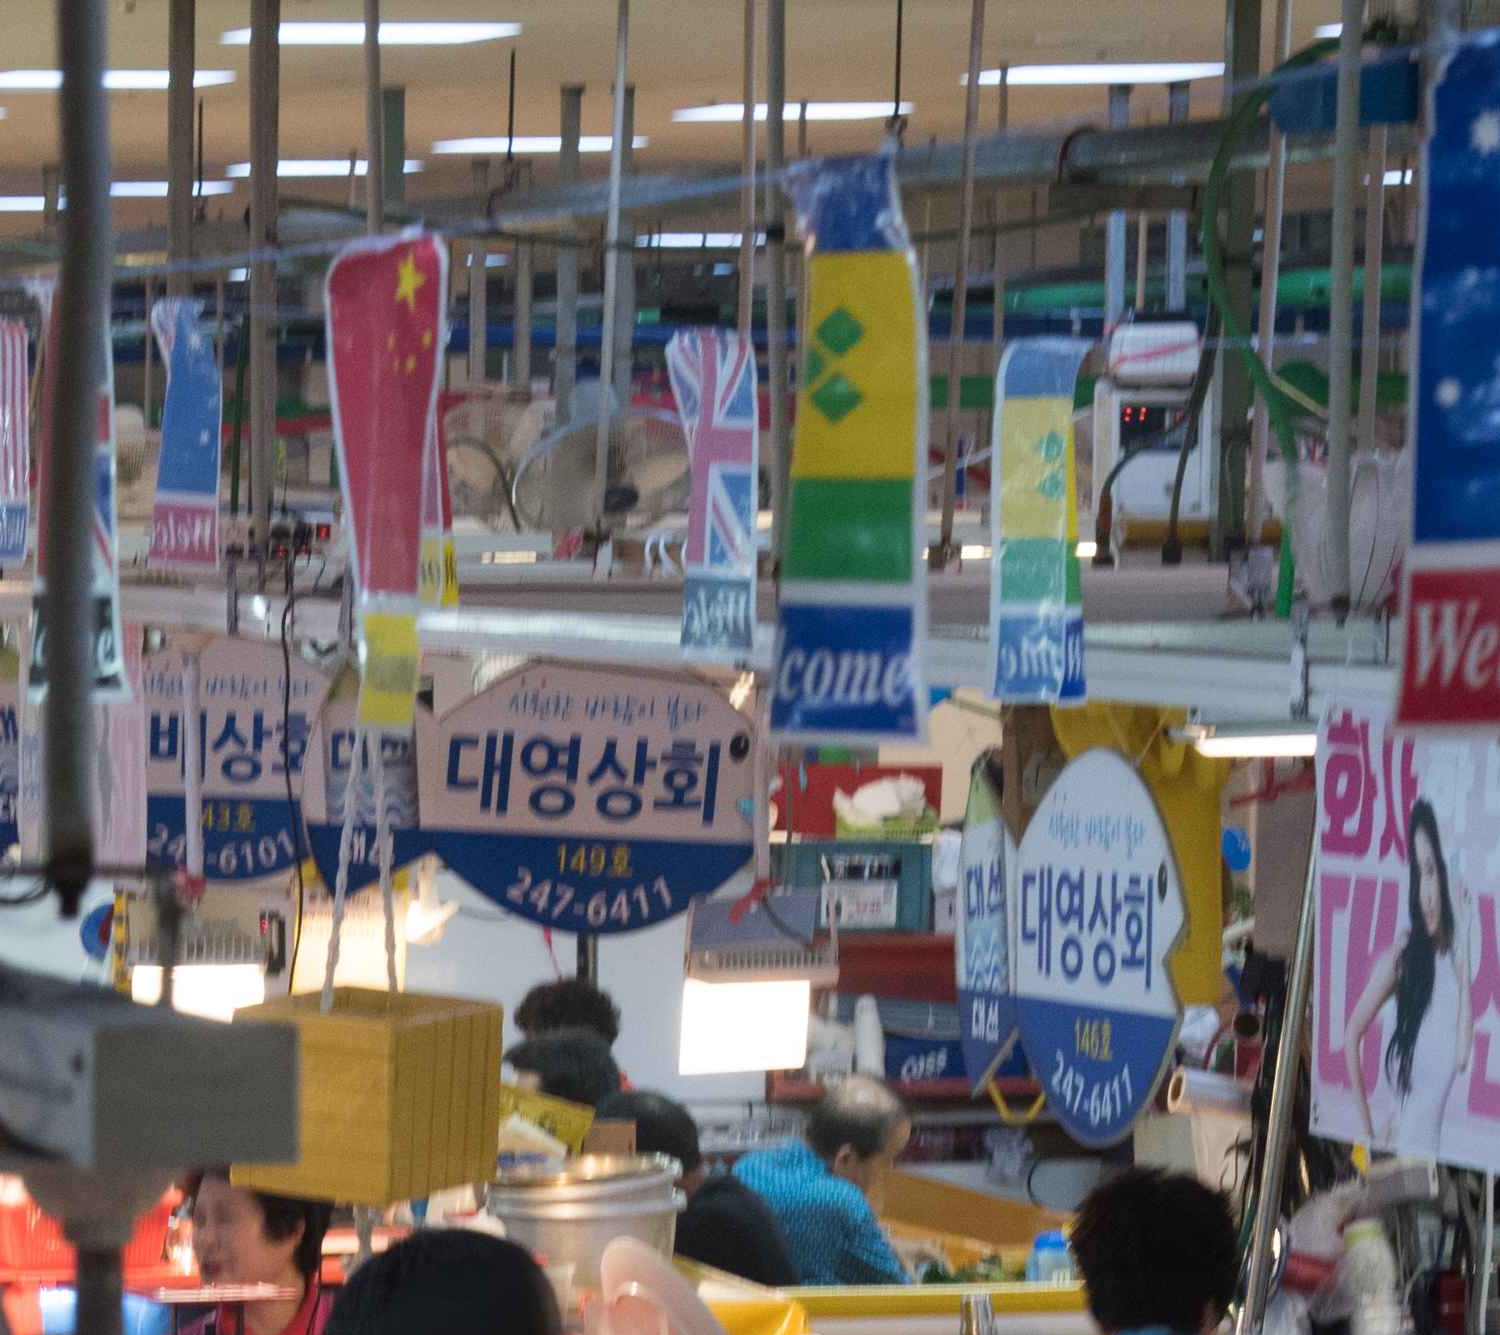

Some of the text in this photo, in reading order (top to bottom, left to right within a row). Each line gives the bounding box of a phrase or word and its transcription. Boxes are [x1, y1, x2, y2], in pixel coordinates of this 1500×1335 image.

[149, 707, 312, 785] 배상회
[446, 729, 722, 826] 대영상회
[148, 822, 295, 878] 24-6101
[506, 868, 674, 927] 247-6411
[1021, 861, 1154, 995] 대영상회
[1051, 1049, 1133, 1126] 247-6411
